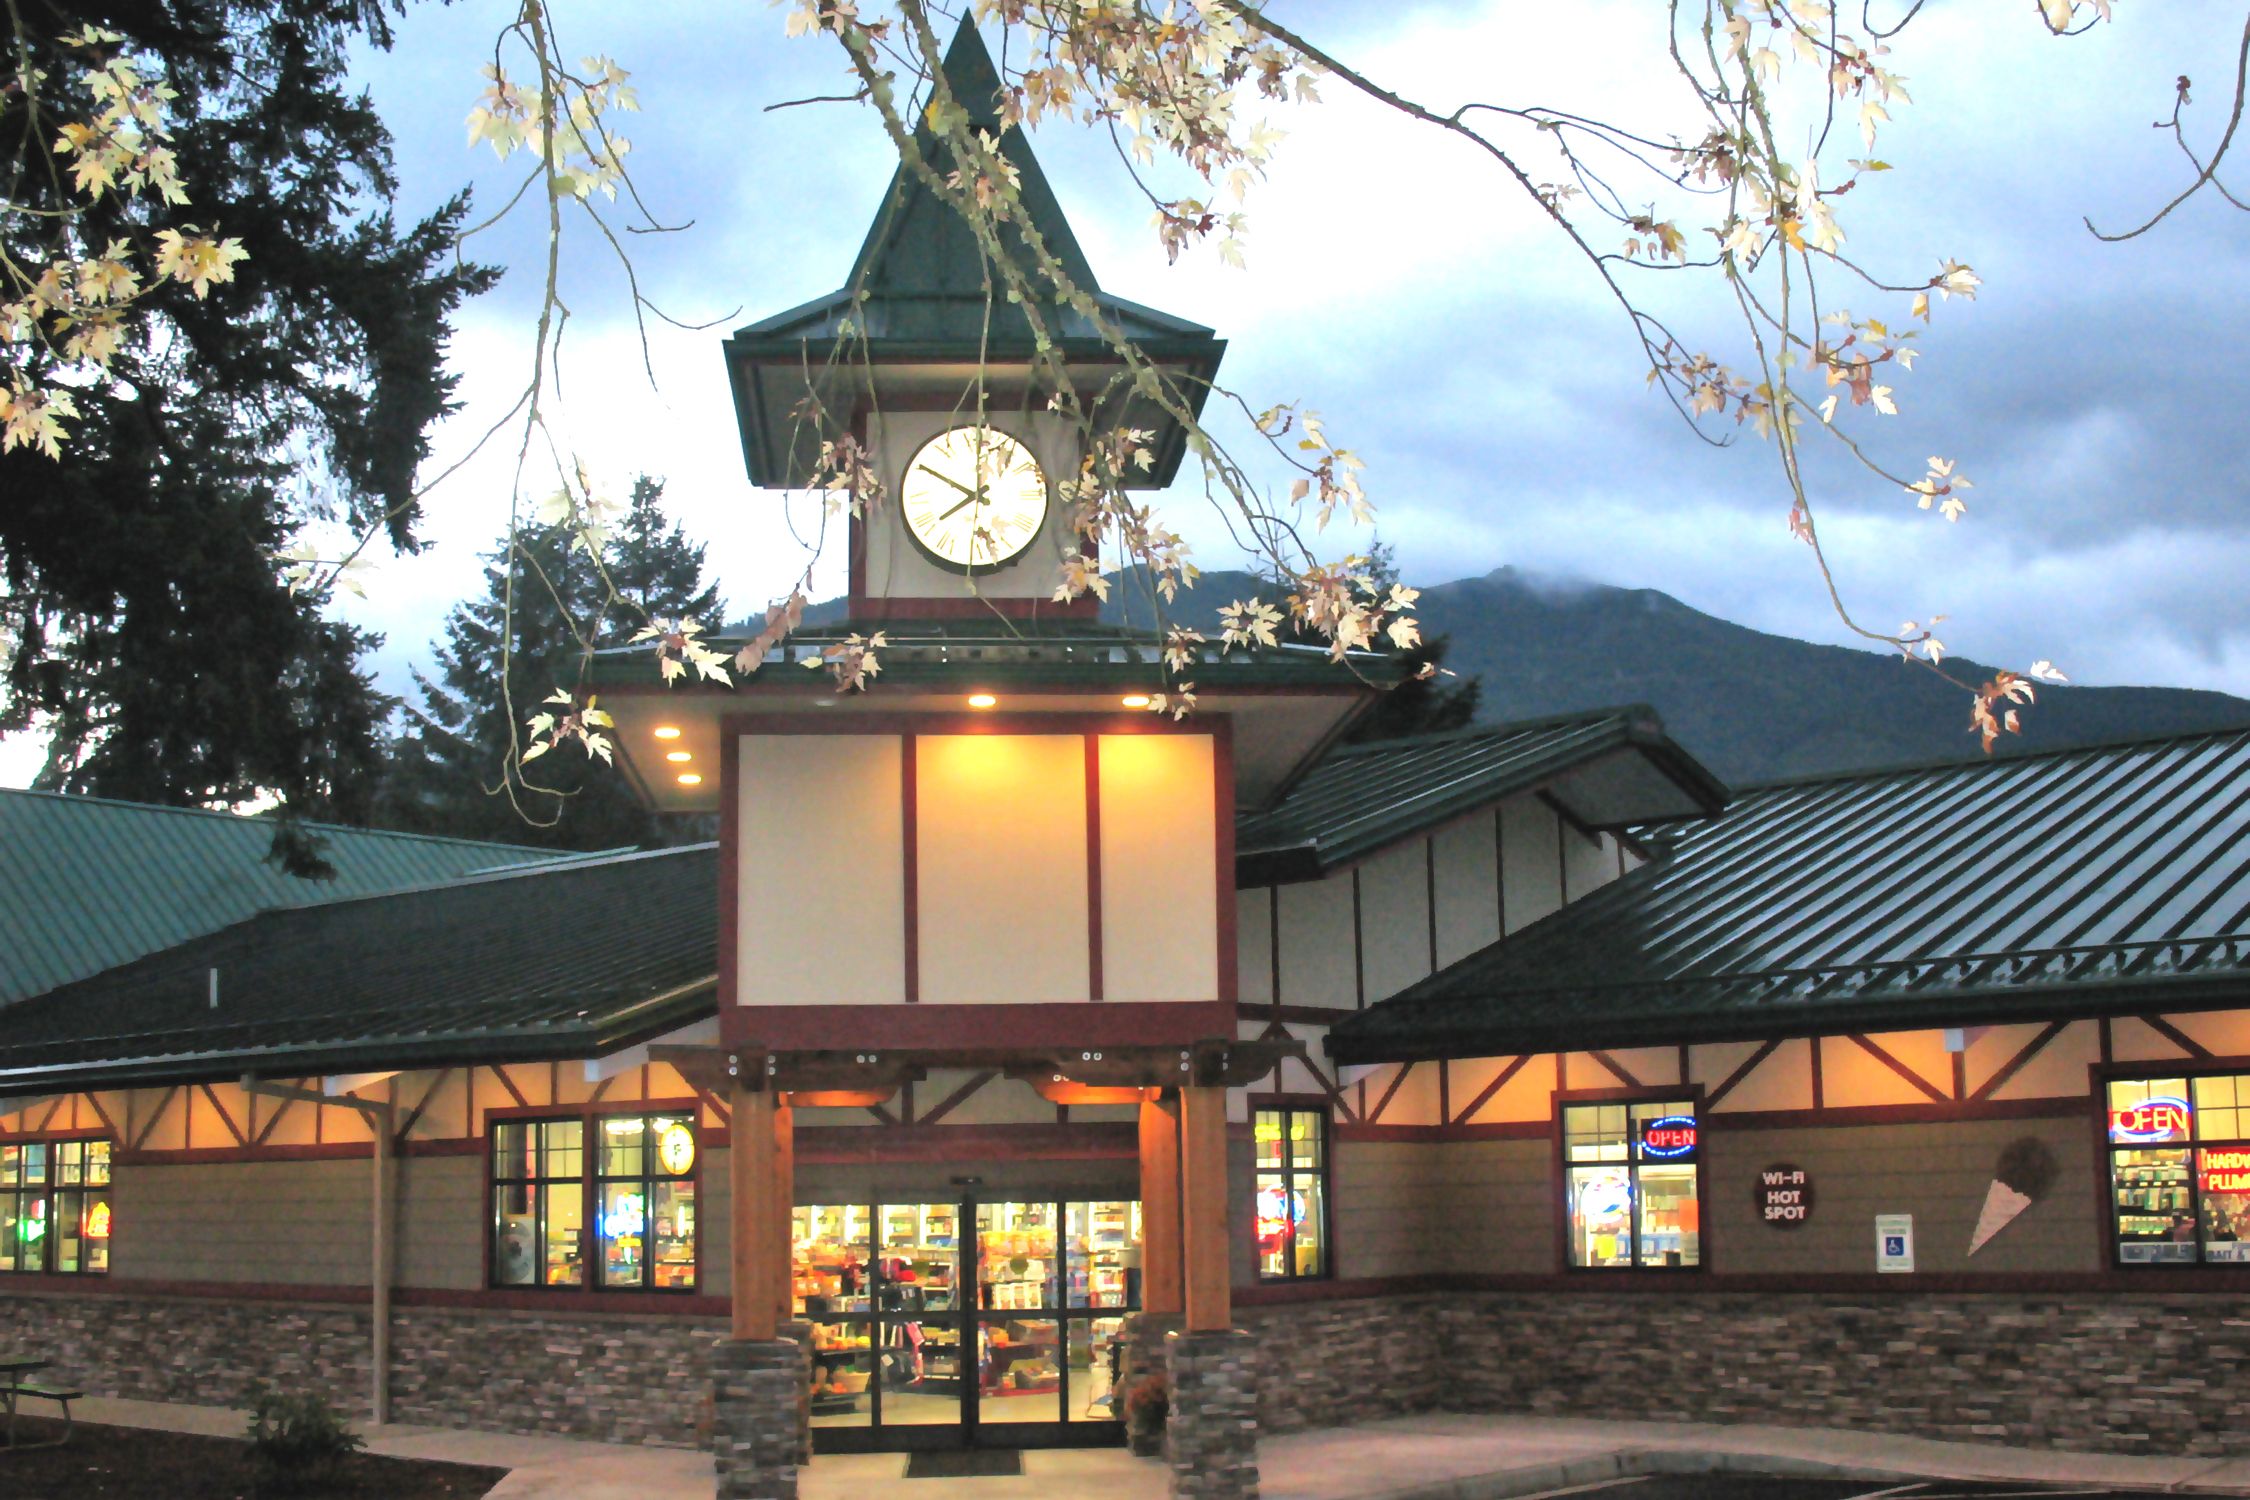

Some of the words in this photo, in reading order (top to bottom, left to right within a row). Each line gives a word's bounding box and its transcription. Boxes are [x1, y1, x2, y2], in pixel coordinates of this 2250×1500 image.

[2118, 1107, 2188, 1131] OPEN
[1647, 1129, 1697, 1146] OPEN
[1763, 1171, 1805, 1185] WI-FI
[1767, 1191, 1801, 1204] HOT
[1765, 1206, 1805, 1220] SPOT
